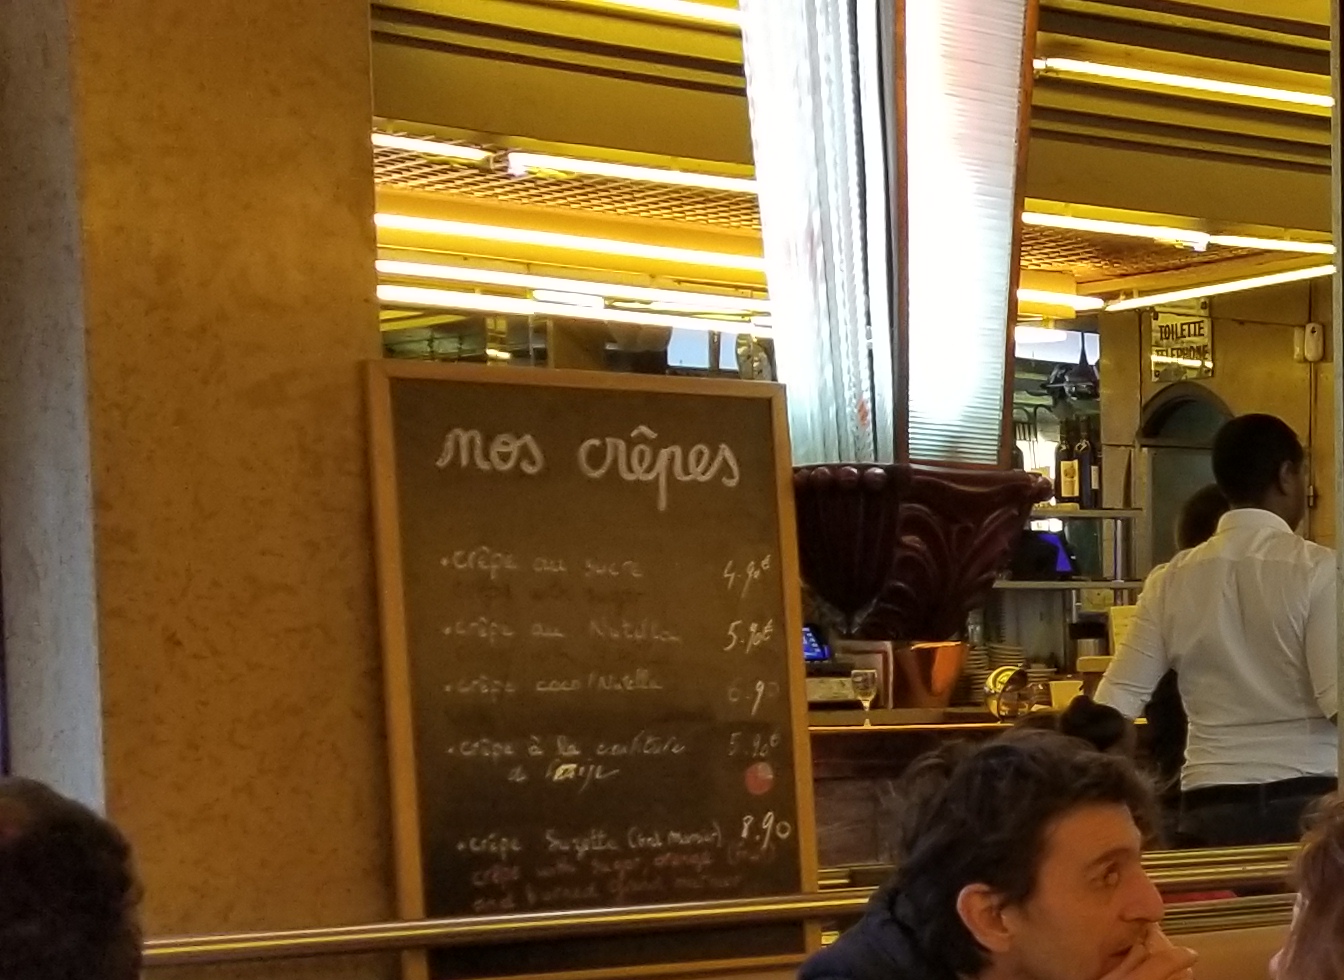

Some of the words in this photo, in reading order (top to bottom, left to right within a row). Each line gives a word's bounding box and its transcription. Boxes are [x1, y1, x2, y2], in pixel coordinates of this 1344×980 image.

[1158, 320, 1205, 342] TOILETTE
[435, 427, 545, 475] nos
[577, 424, 741, 512] crêpes
